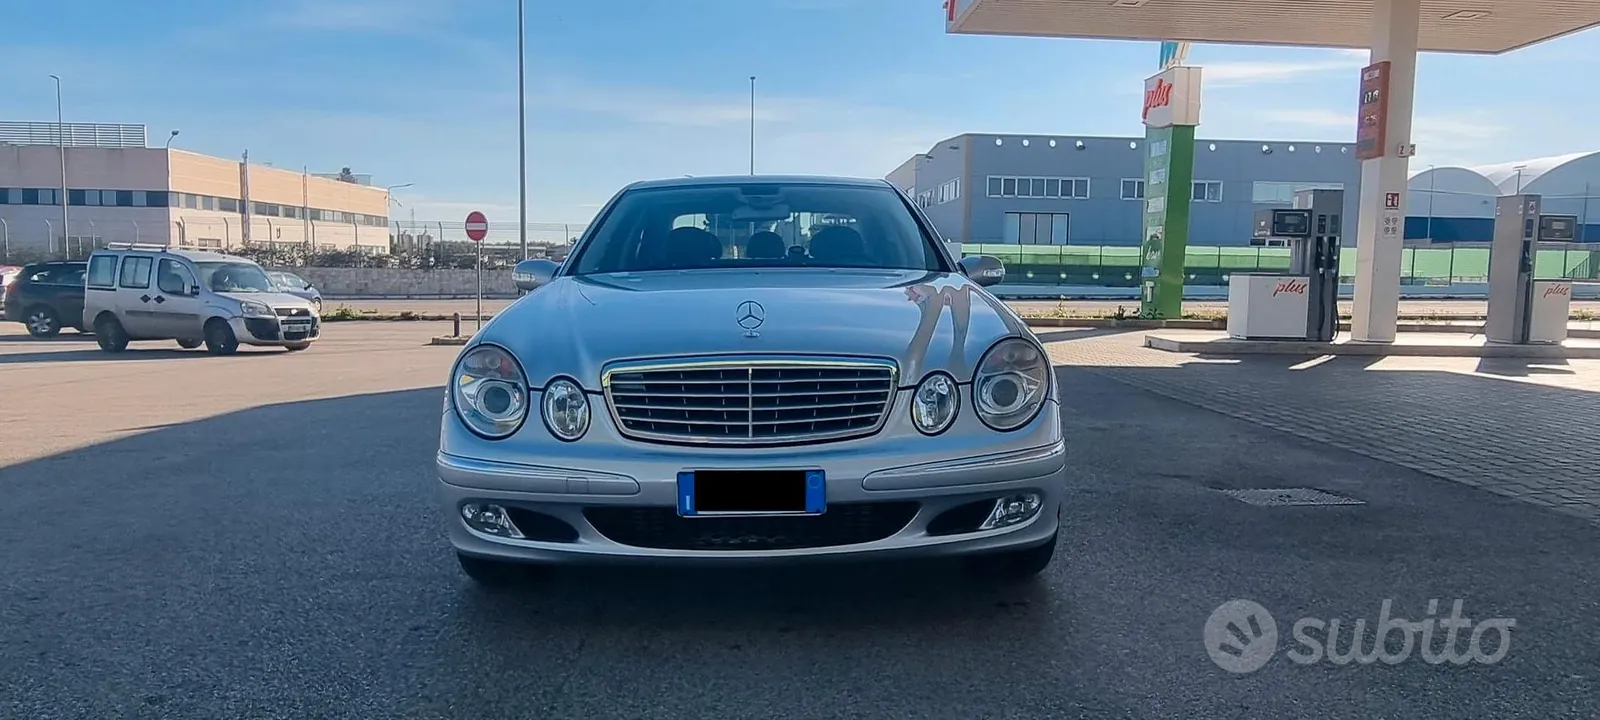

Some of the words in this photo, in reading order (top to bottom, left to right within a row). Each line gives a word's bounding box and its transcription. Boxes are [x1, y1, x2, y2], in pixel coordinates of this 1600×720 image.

[1142, 78, 1173, 120] plus
[1273, 279, 1307, 297] plus
[1543, 283, 1569, 298] plus
